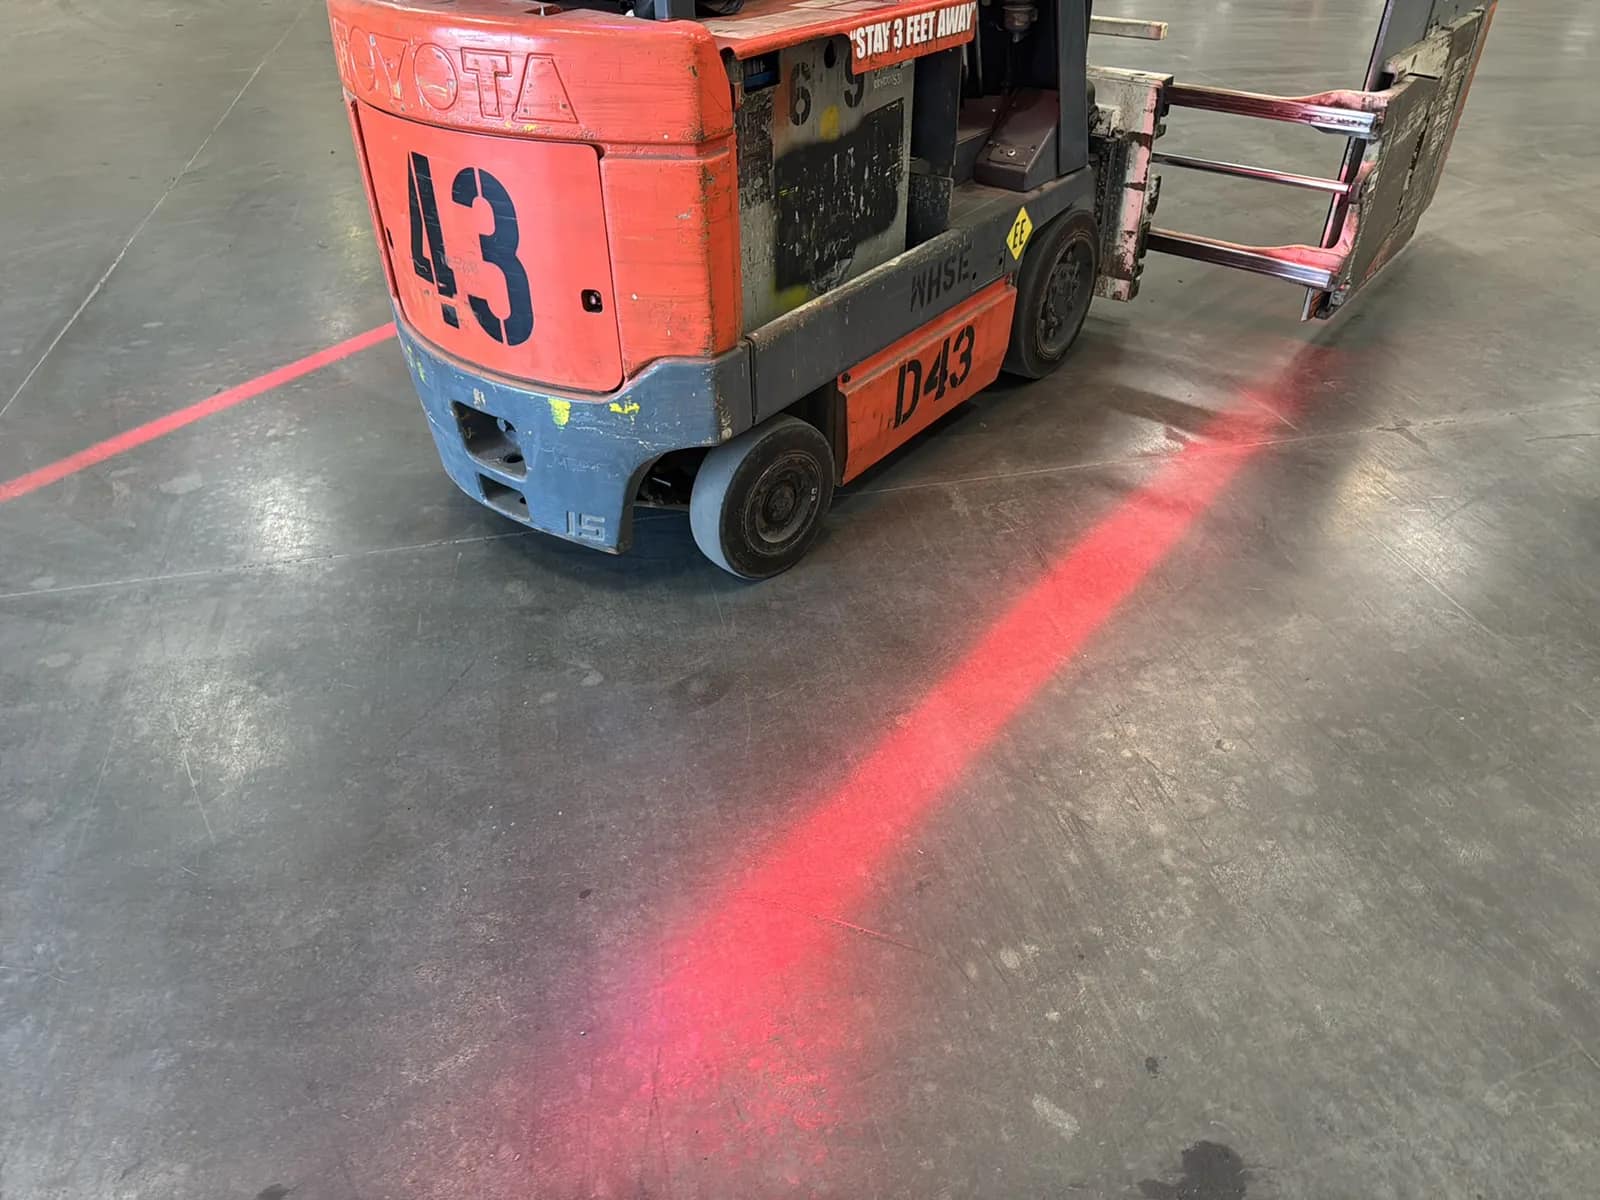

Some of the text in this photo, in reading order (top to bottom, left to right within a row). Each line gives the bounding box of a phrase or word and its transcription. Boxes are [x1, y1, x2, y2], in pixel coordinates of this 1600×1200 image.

[894, 18, 903, 48] 3
[906, 11, 936, 46] FEET
[333, 18, 580, 124] TOYOTA
[407, 150, 535, 347] 43
[1012, 218, 1026, 250] EE
[893, 325, 975, 429] D43
[566, 510, 606, 542] 15
